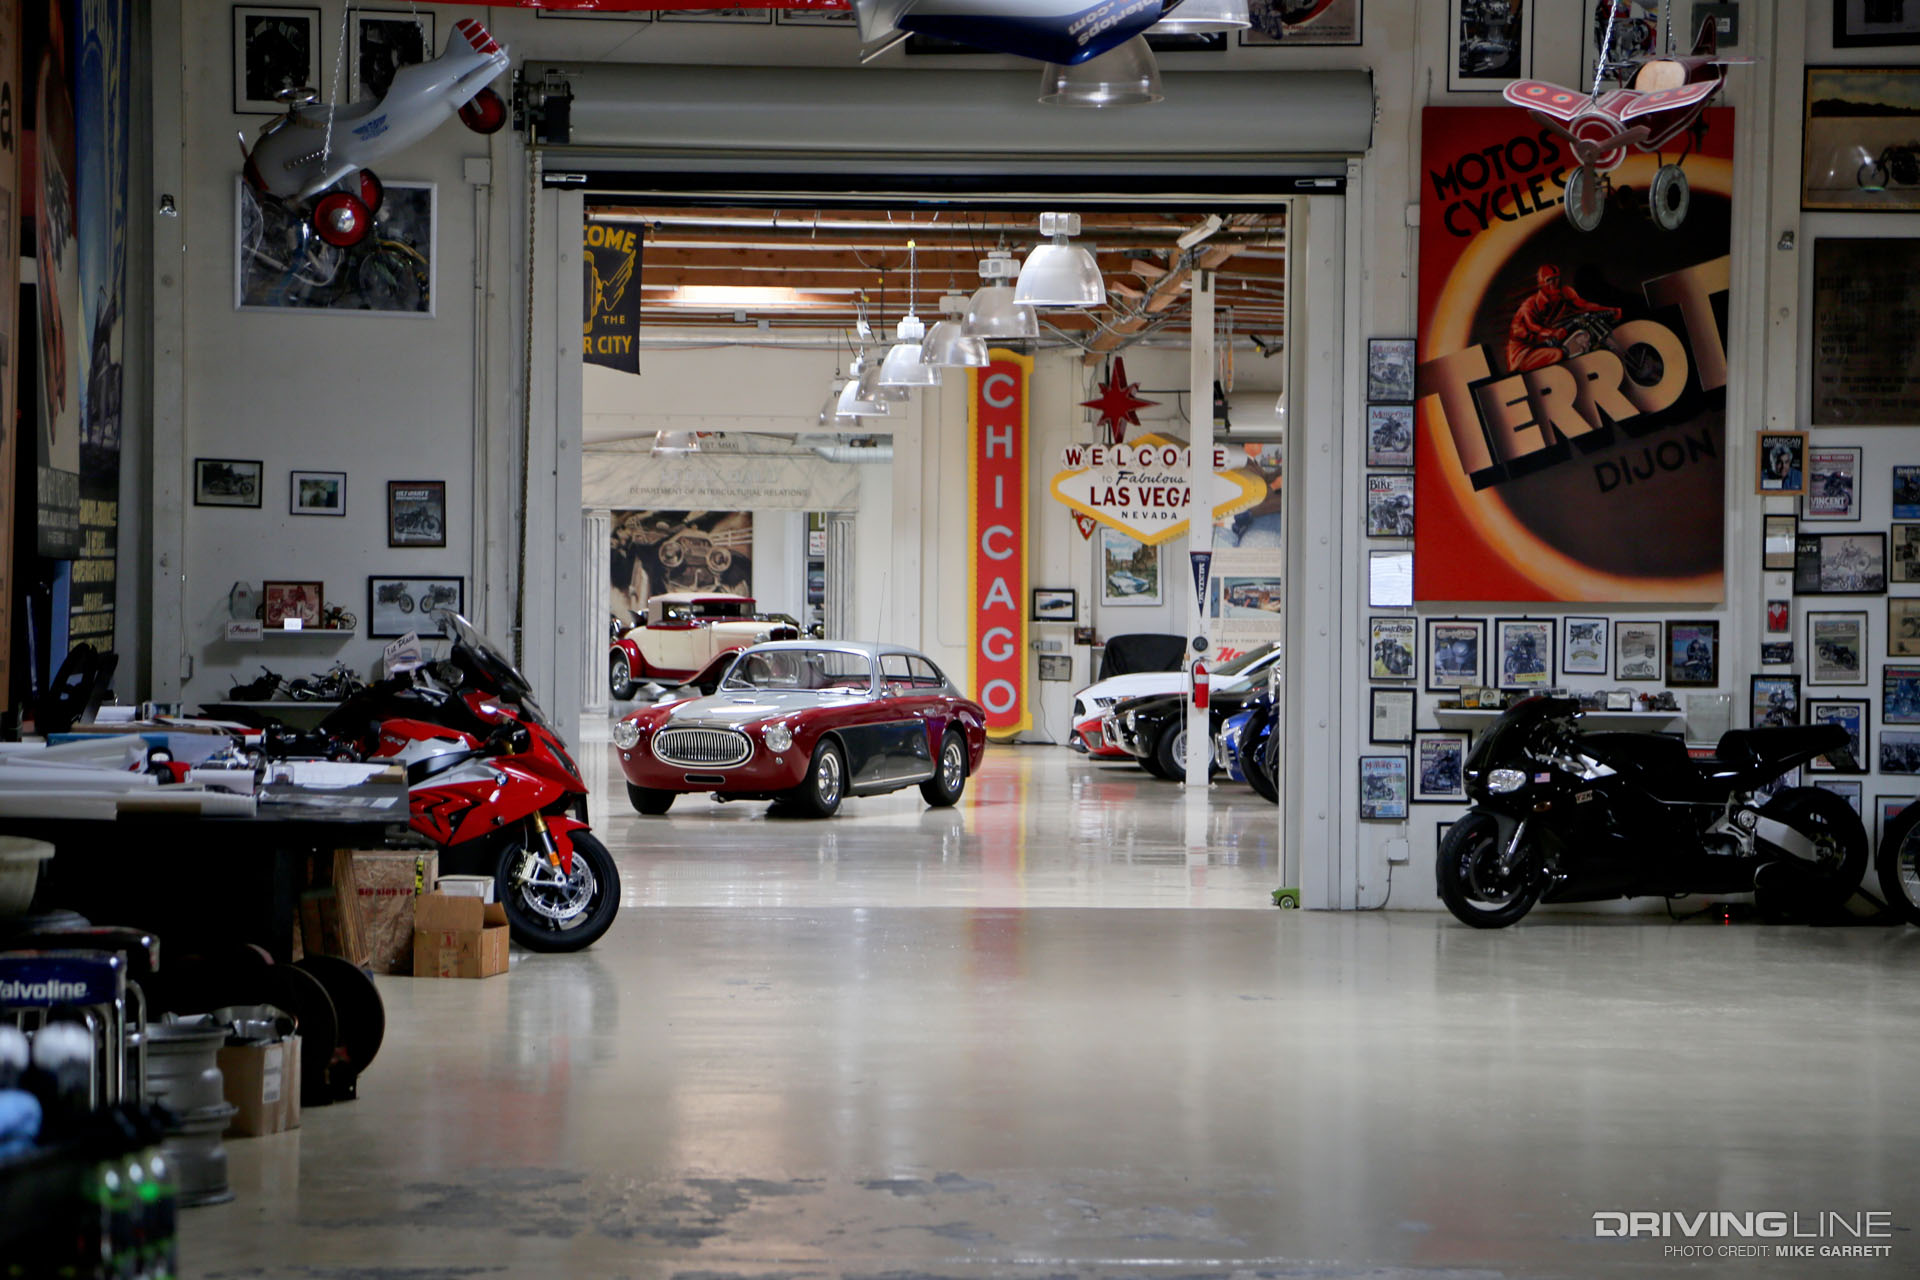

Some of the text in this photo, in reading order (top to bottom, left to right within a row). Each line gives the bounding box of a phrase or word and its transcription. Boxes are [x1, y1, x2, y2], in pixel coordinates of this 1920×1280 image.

[1430, 129, 1561, 201] MOTOS
[1444, 166, 1566, 237] CYCLES
[602, 315, 625, 325] THE
[598, 335, 632, 354] CITY
[1065, 449, 1225, 467] WELCOE
[1594, 428, 1717, 493] DIJON
[1102, 470, 1184, 486] to Fabulous
[629, 487, 683, 495] DEPARTMENT
[685, 487, 693, 495] OF
[1090, 486, 1191, 507] LAS VEGA
[1811, 496, 1845, 505] VINCENT
[1121, 511, 1178, 520] NEVADA
[981, 372, 1017, 714] CHICAGO
[0, 980, 87, 999] alvoline
